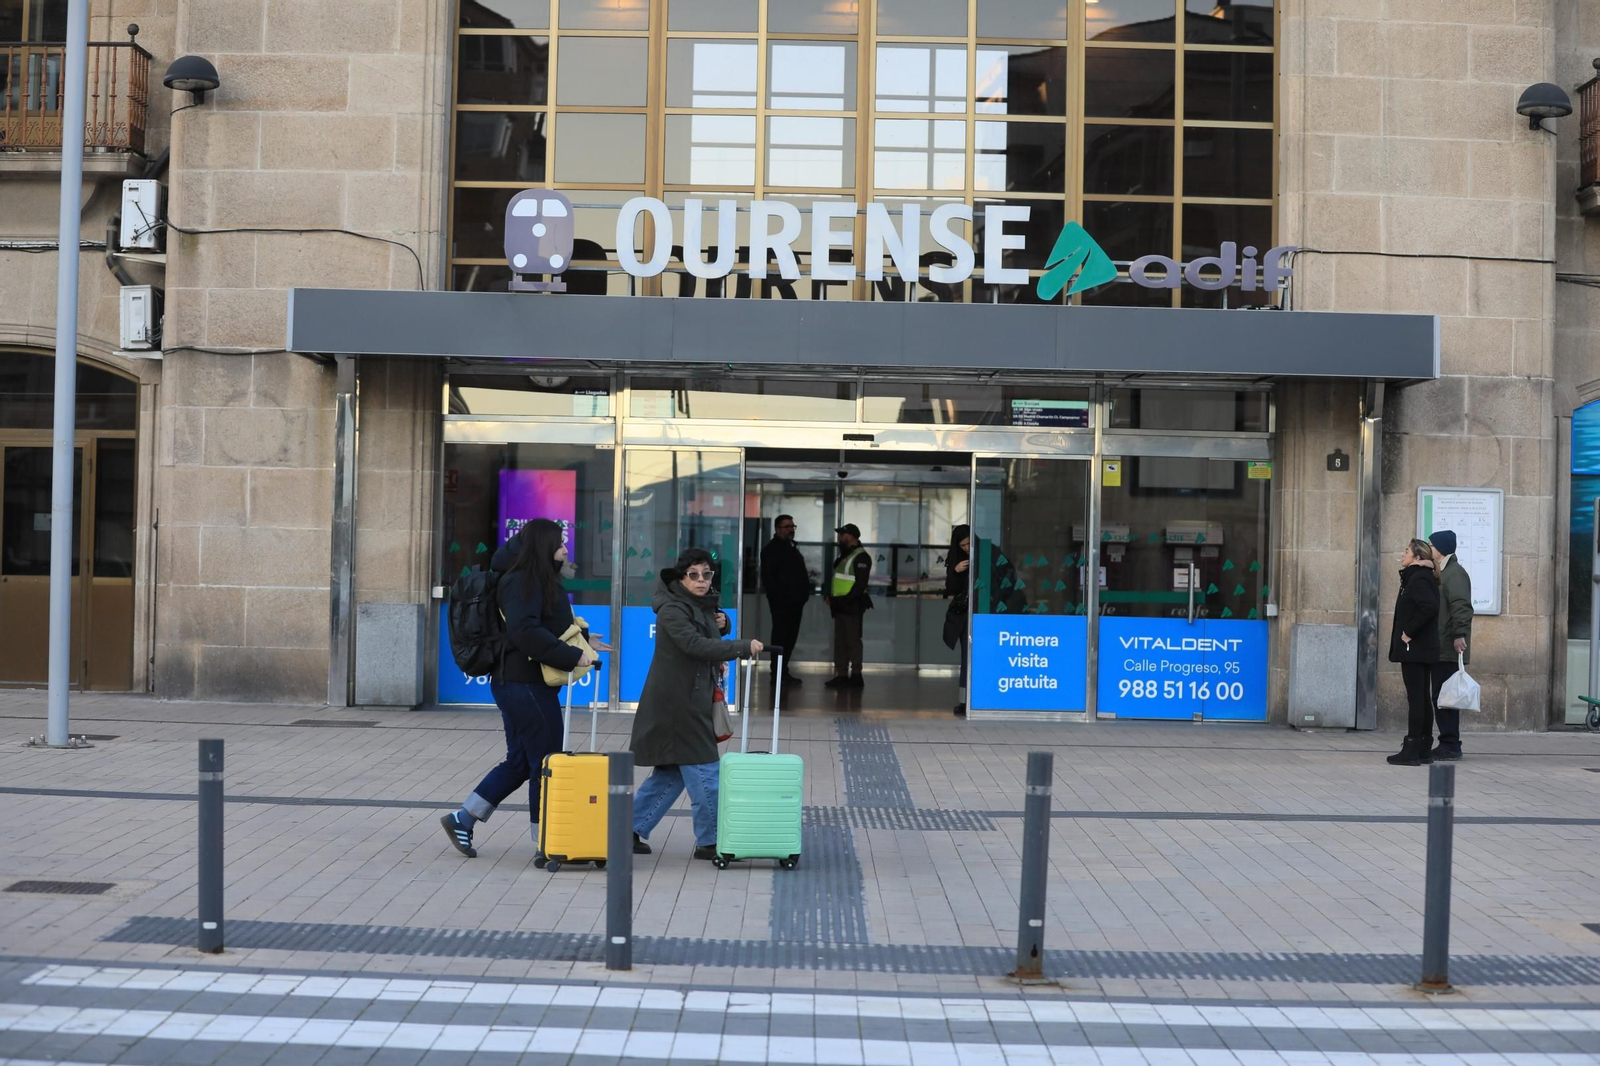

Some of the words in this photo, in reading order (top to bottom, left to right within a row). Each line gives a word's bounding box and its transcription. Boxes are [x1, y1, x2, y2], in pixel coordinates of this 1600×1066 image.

[615, 196, 1031, 285] OURENSE
[1128, 241, 1298, 292] adif
[1335, 458, 1341, 468] 5
[999, 631, 1059, 647] Primera
[1119, 636, 1243, 652] VITALDENT
[1008, 653, 1048, 668] visita
[1123, 658, 1157, 673] Calle
[1160, 659, 1221, 677] Progreso,
[1224, 661, 1240, 674] 95
[998, 674, 1058, 693] gratuita
[1118, 679, 1158, 699] 988
[1163, 680, 1183, 700] 51
[1188, 681, 1211, 700] 16
[1216, 681, 1244, 701] 00
